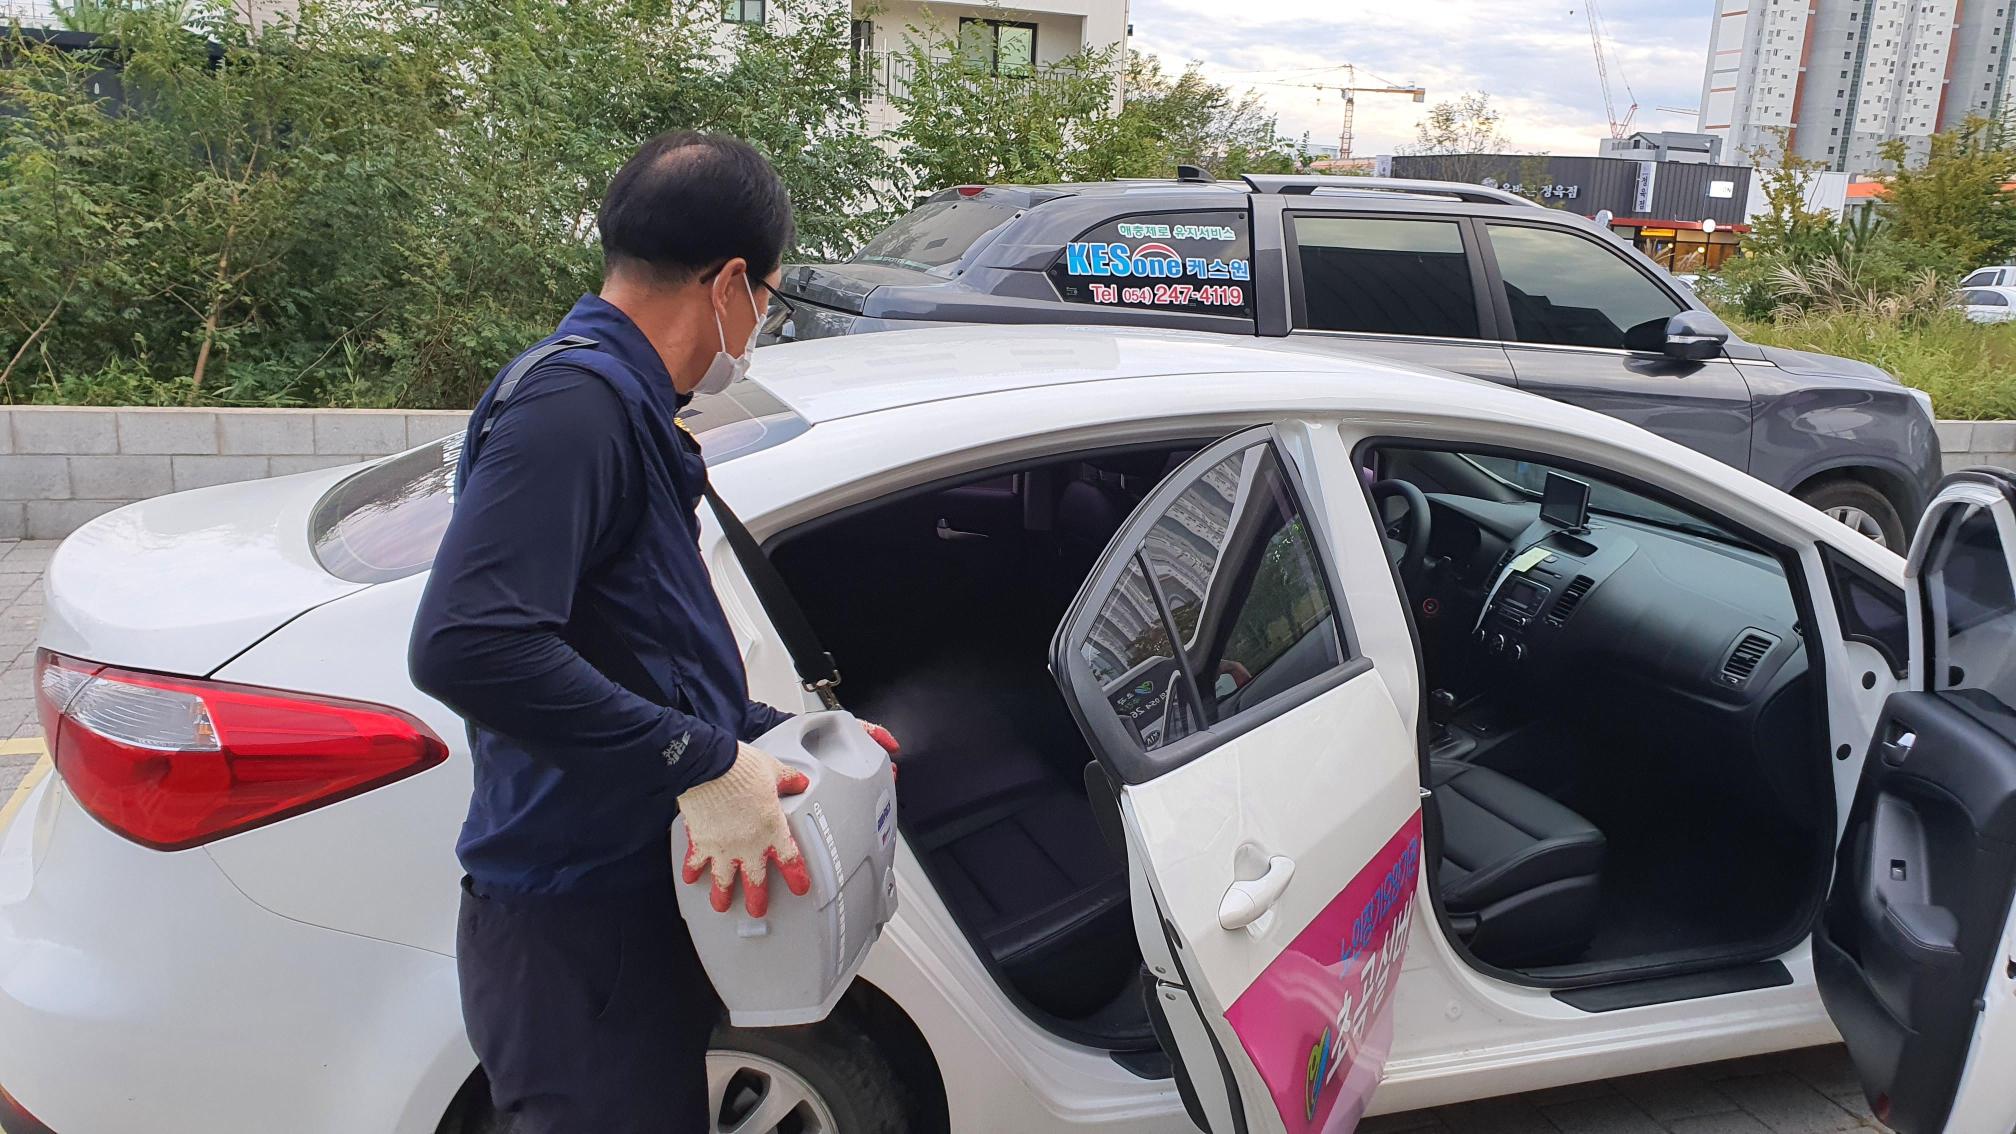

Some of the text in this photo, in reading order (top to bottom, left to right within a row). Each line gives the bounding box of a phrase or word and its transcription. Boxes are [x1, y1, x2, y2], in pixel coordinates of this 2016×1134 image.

[1540, 184, 1578, 199] 정육점
[1118, 223, 1236, 241] 해충제로 유지서비스
[1066, 242, 1250, 281] KESone 케스원
[1089, 284, 1118, 303] Tel
[1154, 284, 1244, 306] 247-4119
